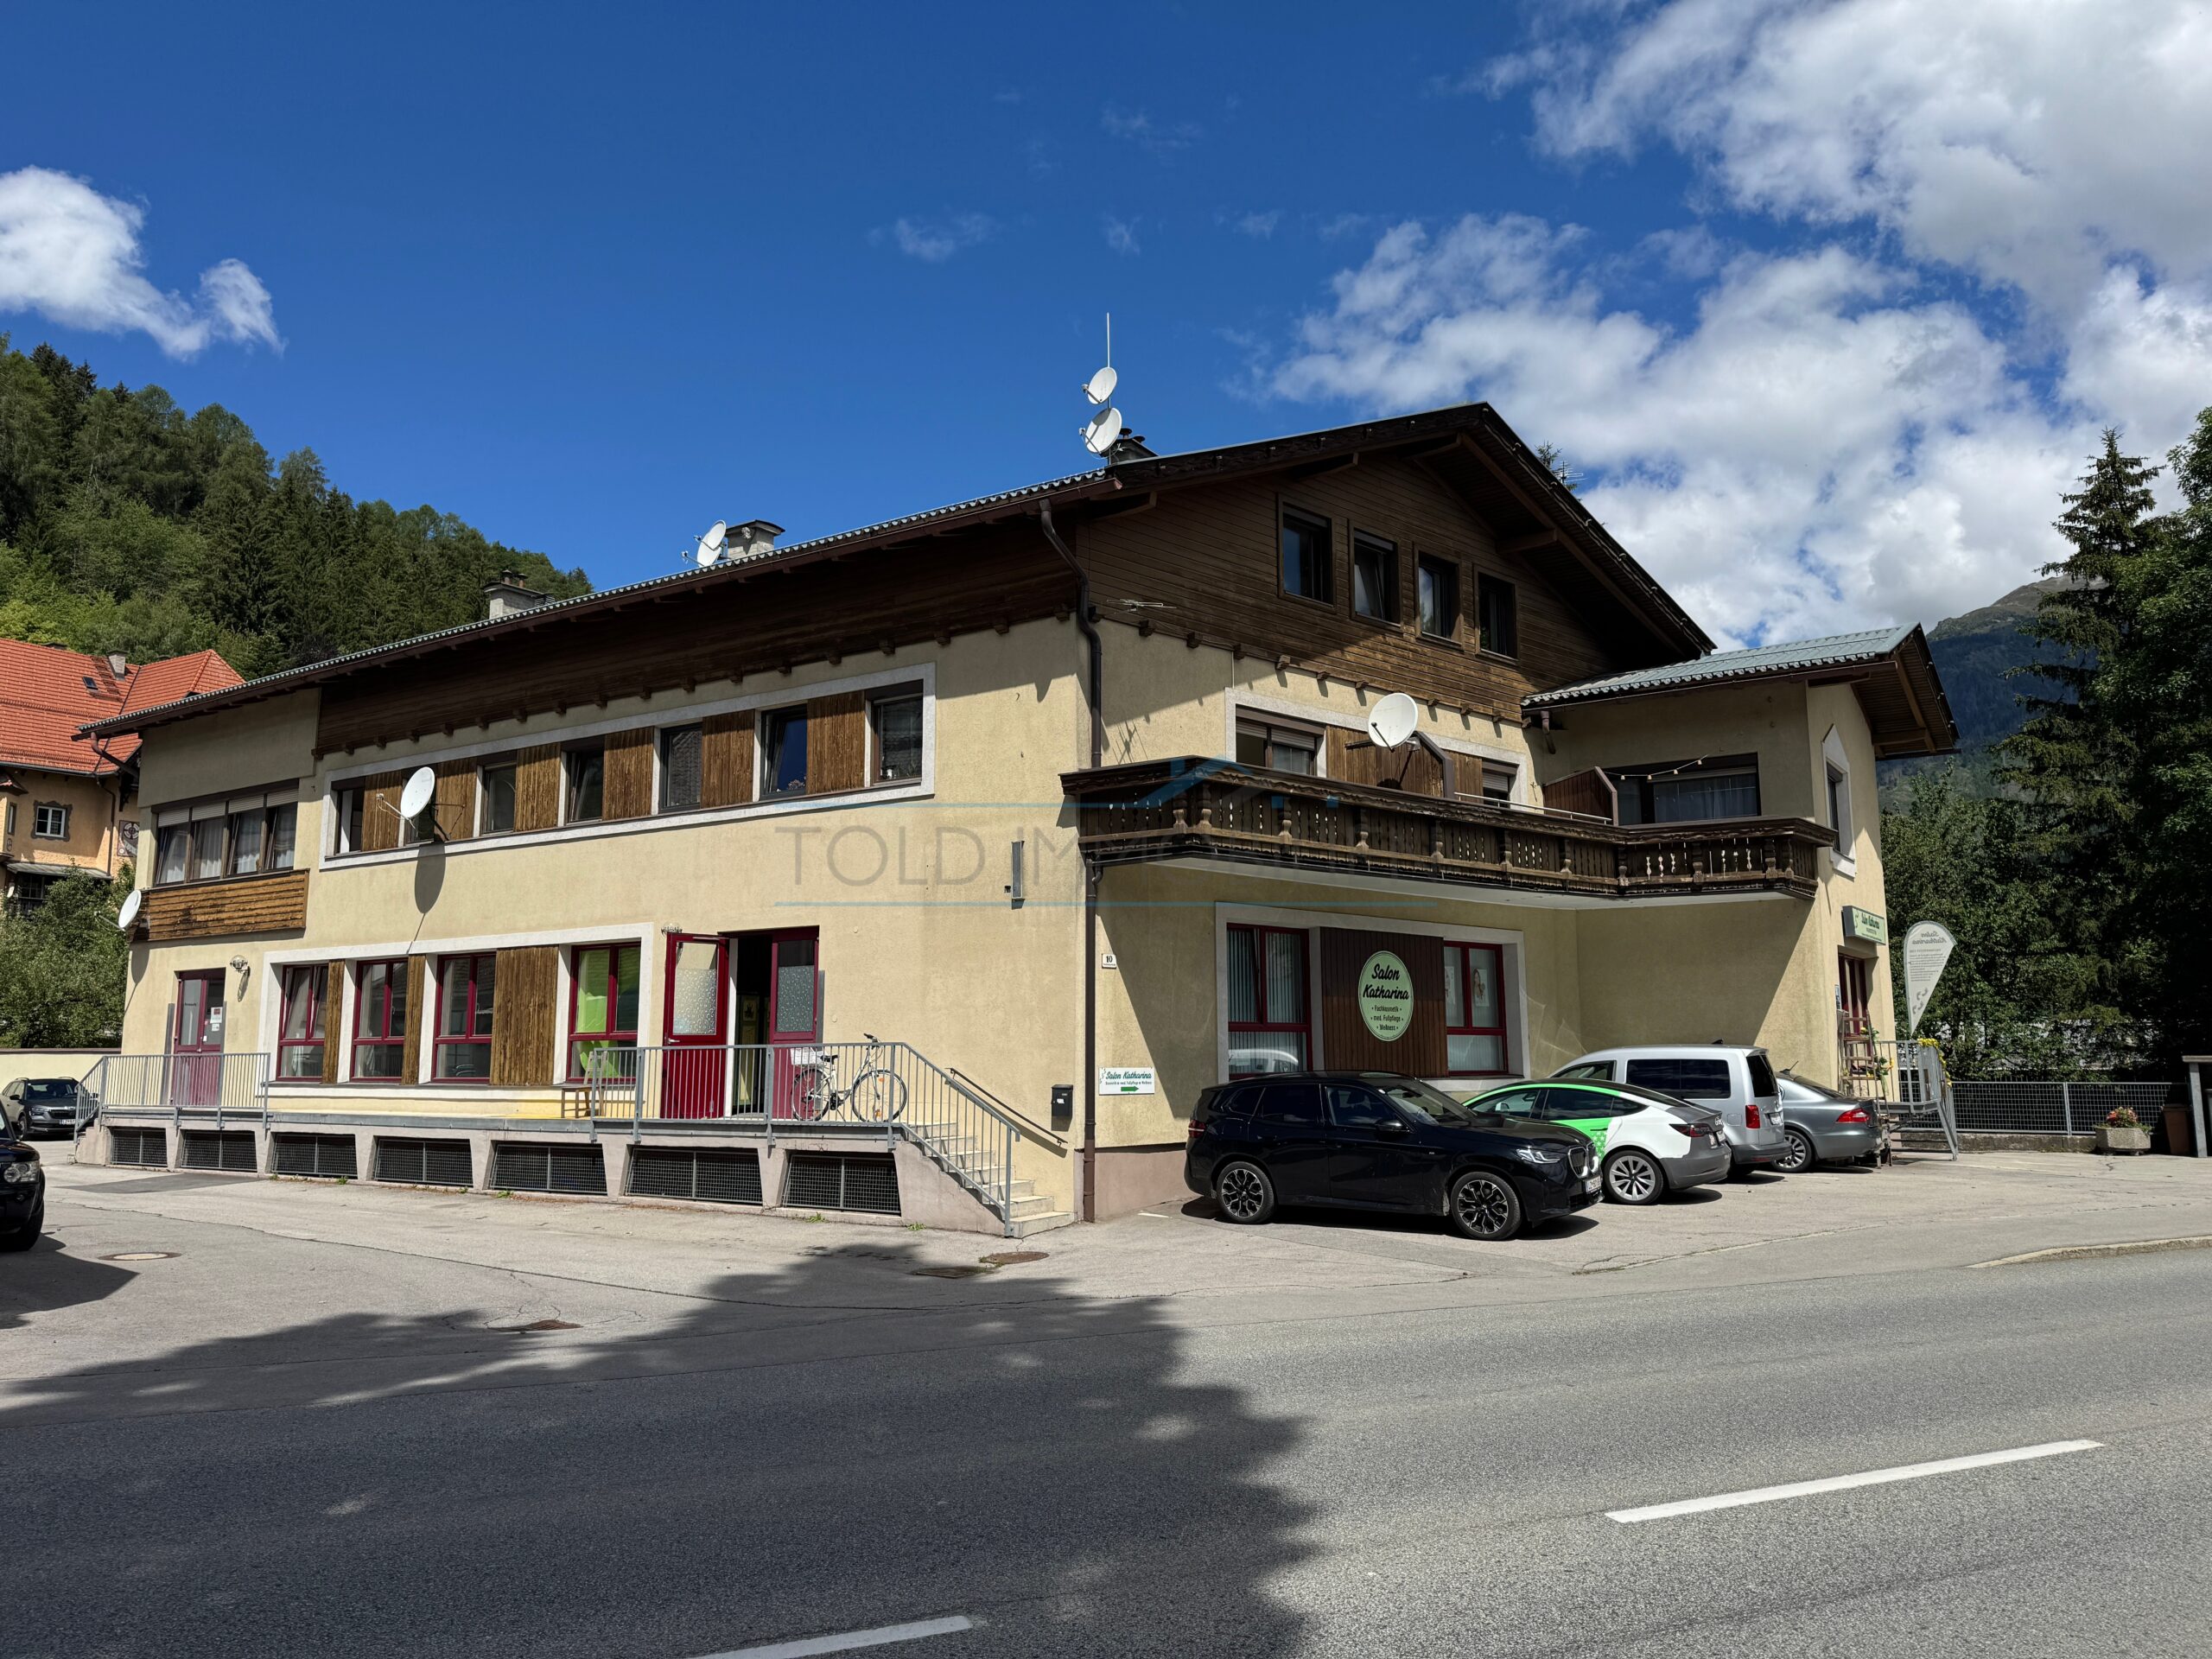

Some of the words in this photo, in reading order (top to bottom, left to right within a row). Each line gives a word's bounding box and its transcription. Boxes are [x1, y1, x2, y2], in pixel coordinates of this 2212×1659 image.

[1106, 955, 1113, 963] 10
[1371, 963, 1400, 981] Salon
[1363, 984, 1409, 1000] Katharina
[1105, 1071, 1122, 1079] Salon
[1122, 1071, 1152, 1079] Katharina
